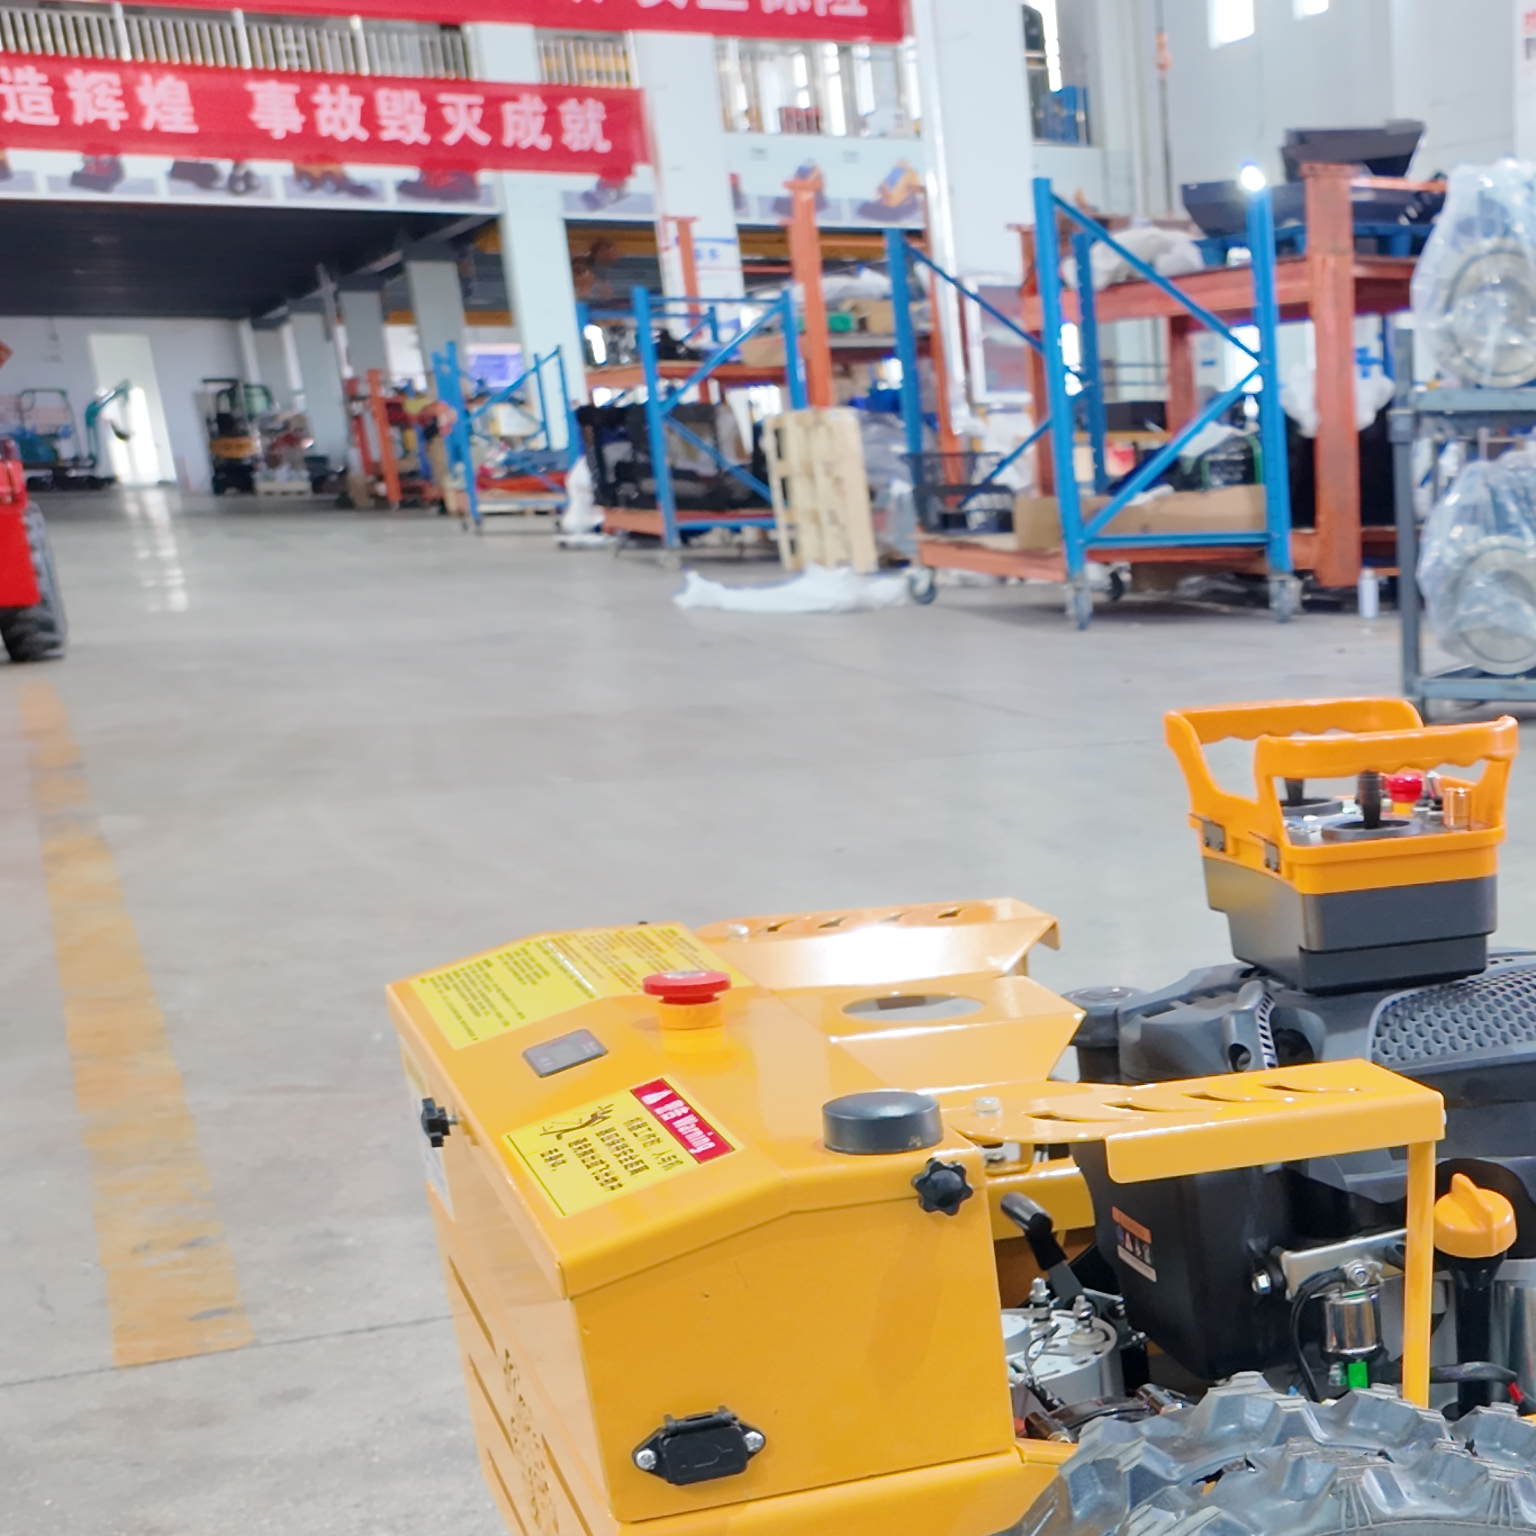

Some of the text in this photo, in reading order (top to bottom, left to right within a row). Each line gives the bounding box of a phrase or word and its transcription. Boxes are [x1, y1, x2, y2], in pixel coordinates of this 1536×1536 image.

[244, 79, 613, 154] 事故毁灭成就
[671, 1113, 716, 1155] Warning
